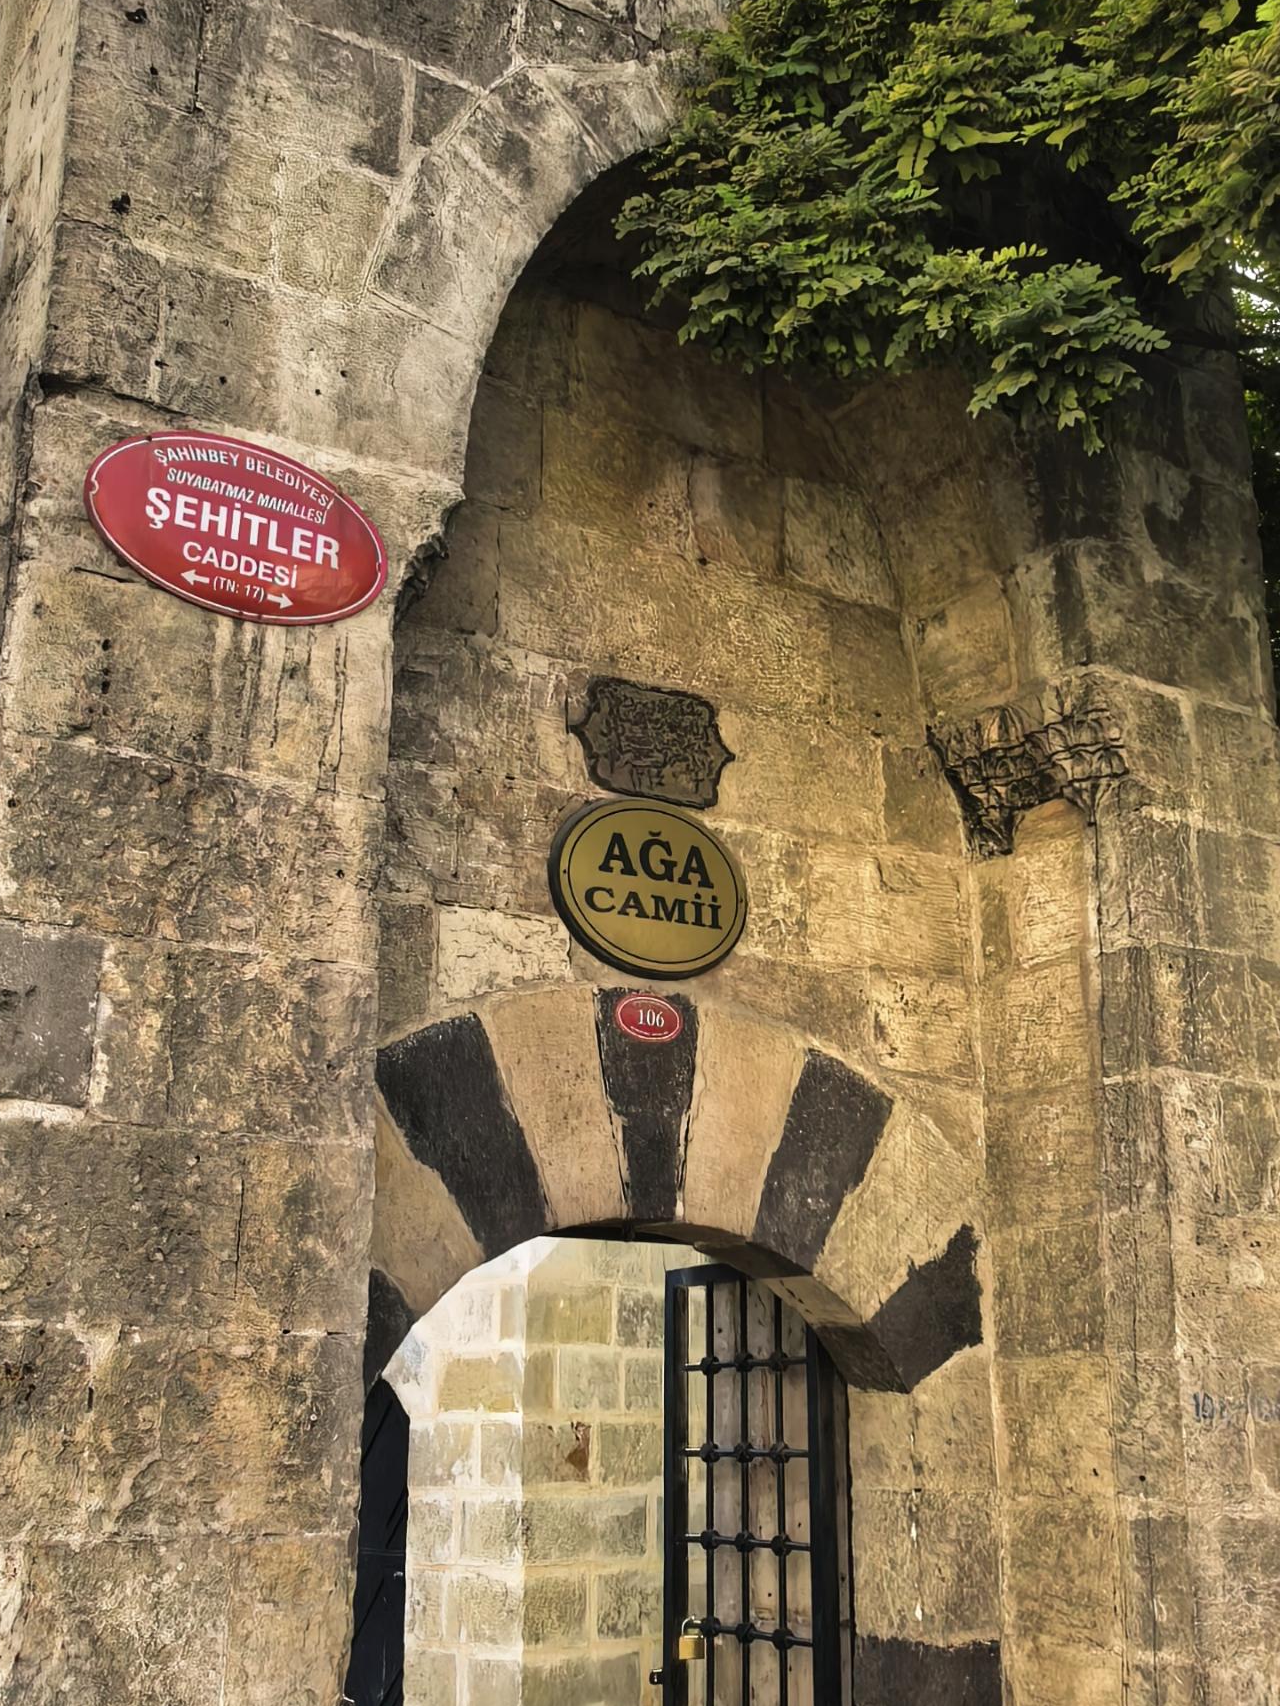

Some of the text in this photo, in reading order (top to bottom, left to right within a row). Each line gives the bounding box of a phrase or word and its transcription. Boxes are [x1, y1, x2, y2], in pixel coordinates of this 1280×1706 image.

[154, 445, 335, 510] ŞAHİNBEY BELEDİYESİ
[167, 468, 329, 525] SUYABATMAZ MAHALLESİ
[145, 487, 340, 570] ŞEHİTLER
[183, 541, 297, 589] CADDESİ
[213, 574, 266, 603] (TN: 17)
[599, 830, 714, 889] AĞA
[585, 887, 722, 930] CAMİİ
[639, 1009, 664, 1027] 106
